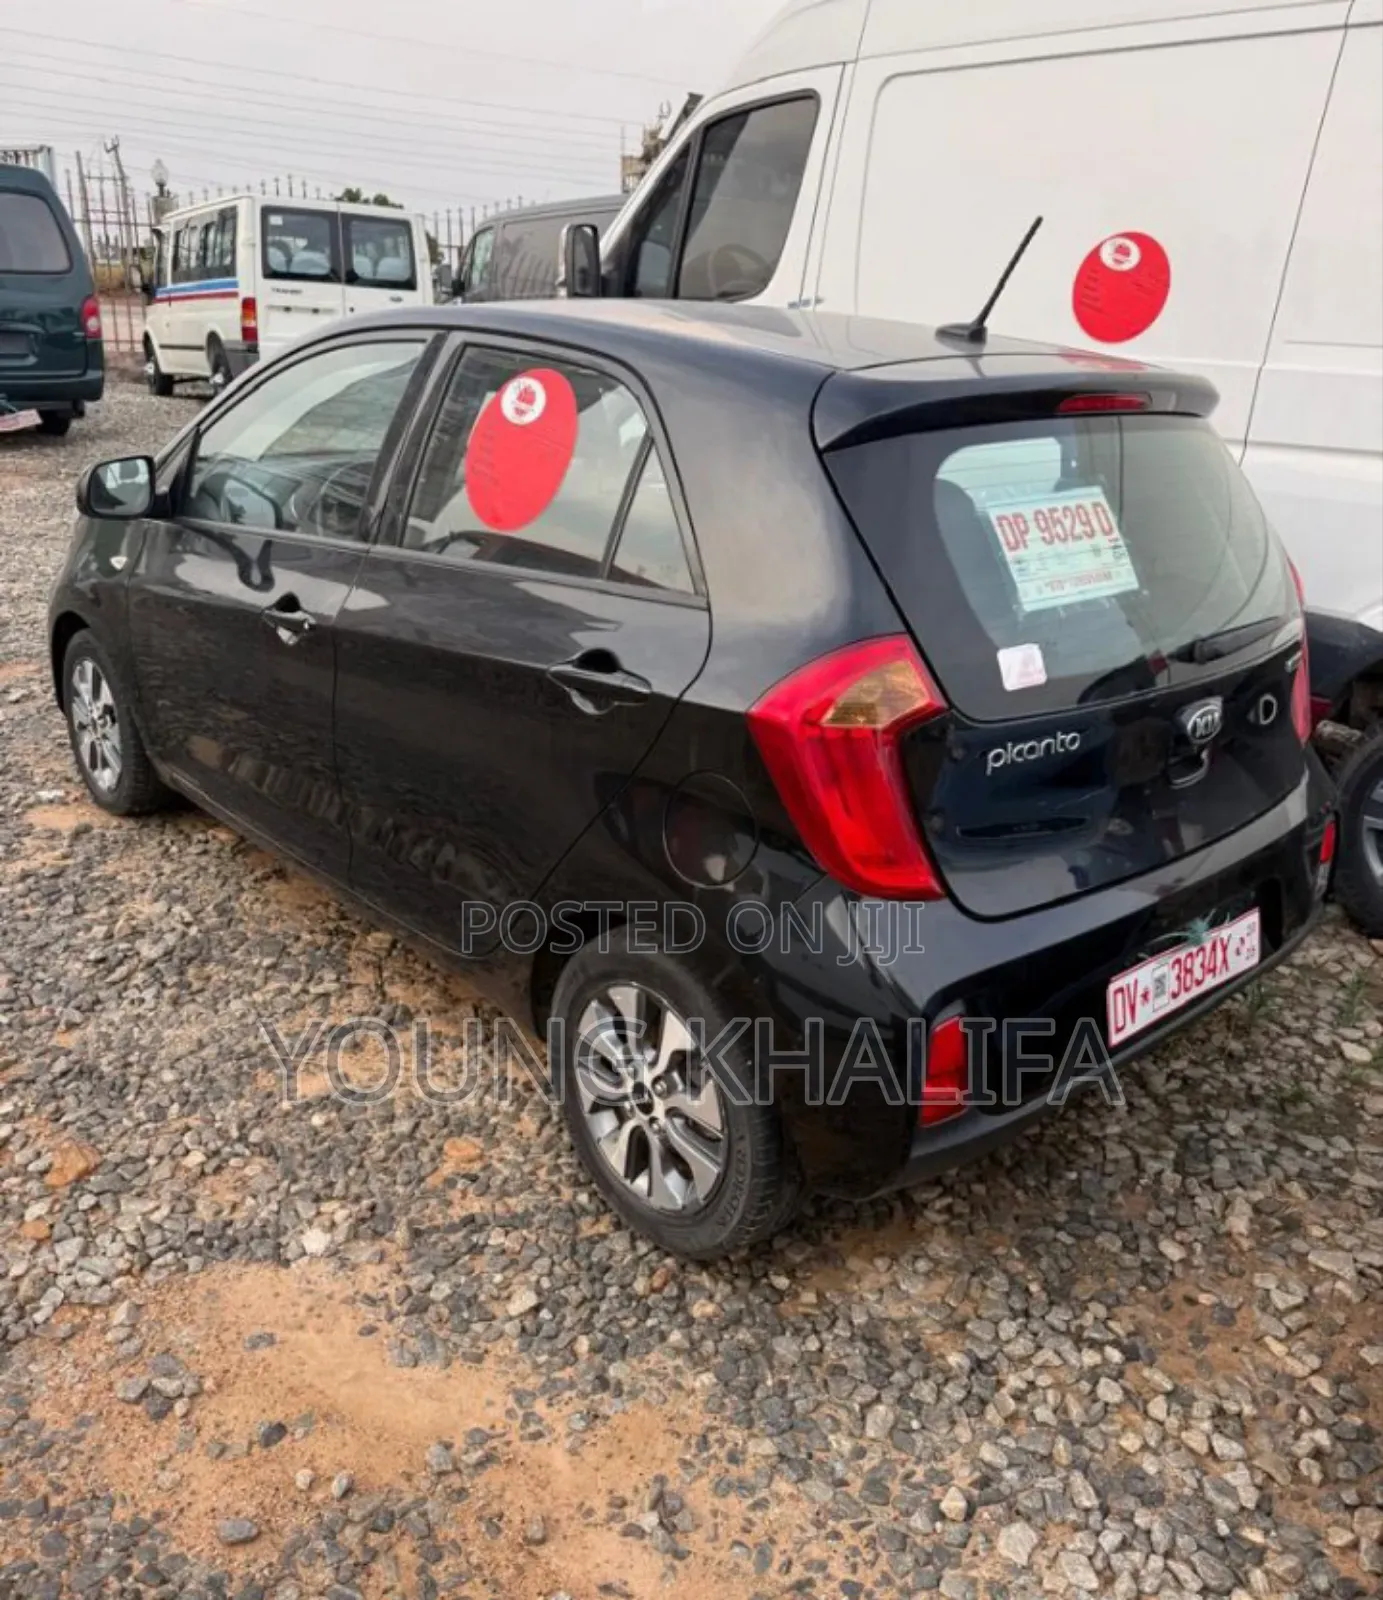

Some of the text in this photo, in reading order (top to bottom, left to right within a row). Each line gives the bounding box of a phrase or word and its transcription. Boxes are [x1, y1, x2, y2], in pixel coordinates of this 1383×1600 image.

[996, 511, 1030, 552] DP
[1033, 503, 1095, 546] 9529
[986, 731, 1081, 776] picanto
[1113, 933, 1232, 1035] DV 3834X
